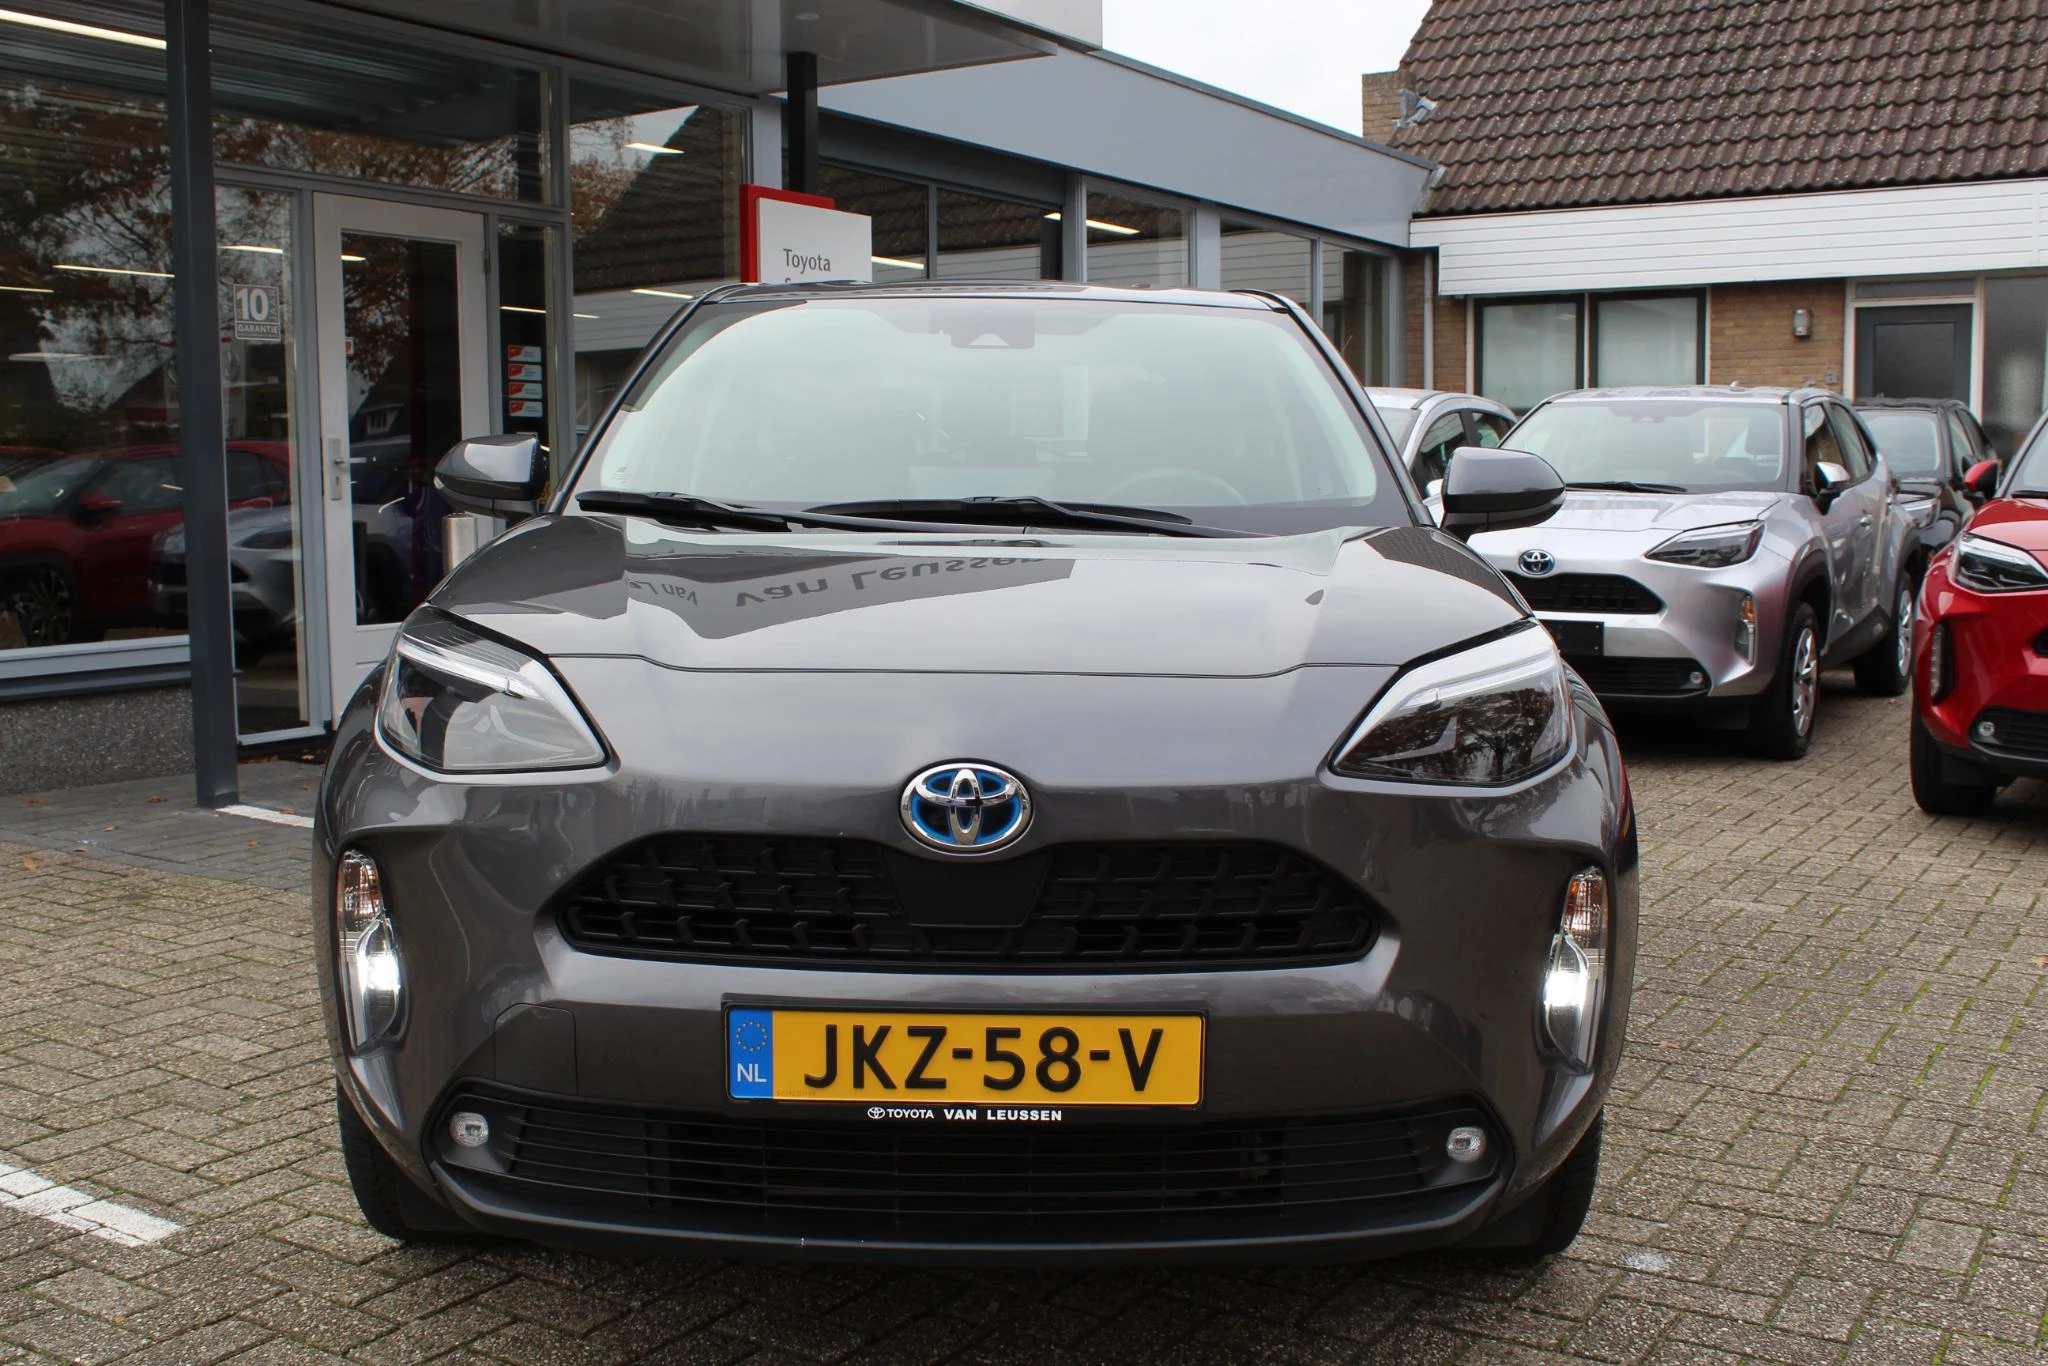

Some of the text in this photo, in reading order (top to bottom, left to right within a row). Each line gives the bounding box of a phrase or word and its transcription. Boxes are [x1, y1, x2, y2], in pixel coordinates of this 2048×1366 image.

[783, 248, 831, 274] Toyota
[236, 288, 269, 320] 10
[238, 324, 278, 333] GARANTIE
[804, 1024, 1165, 1093] JKZ-58-V
[737, 1063, 767, 1083] NL
[886, 1108, 1062, 1121] TOYOTA VAN LEUSSEN
